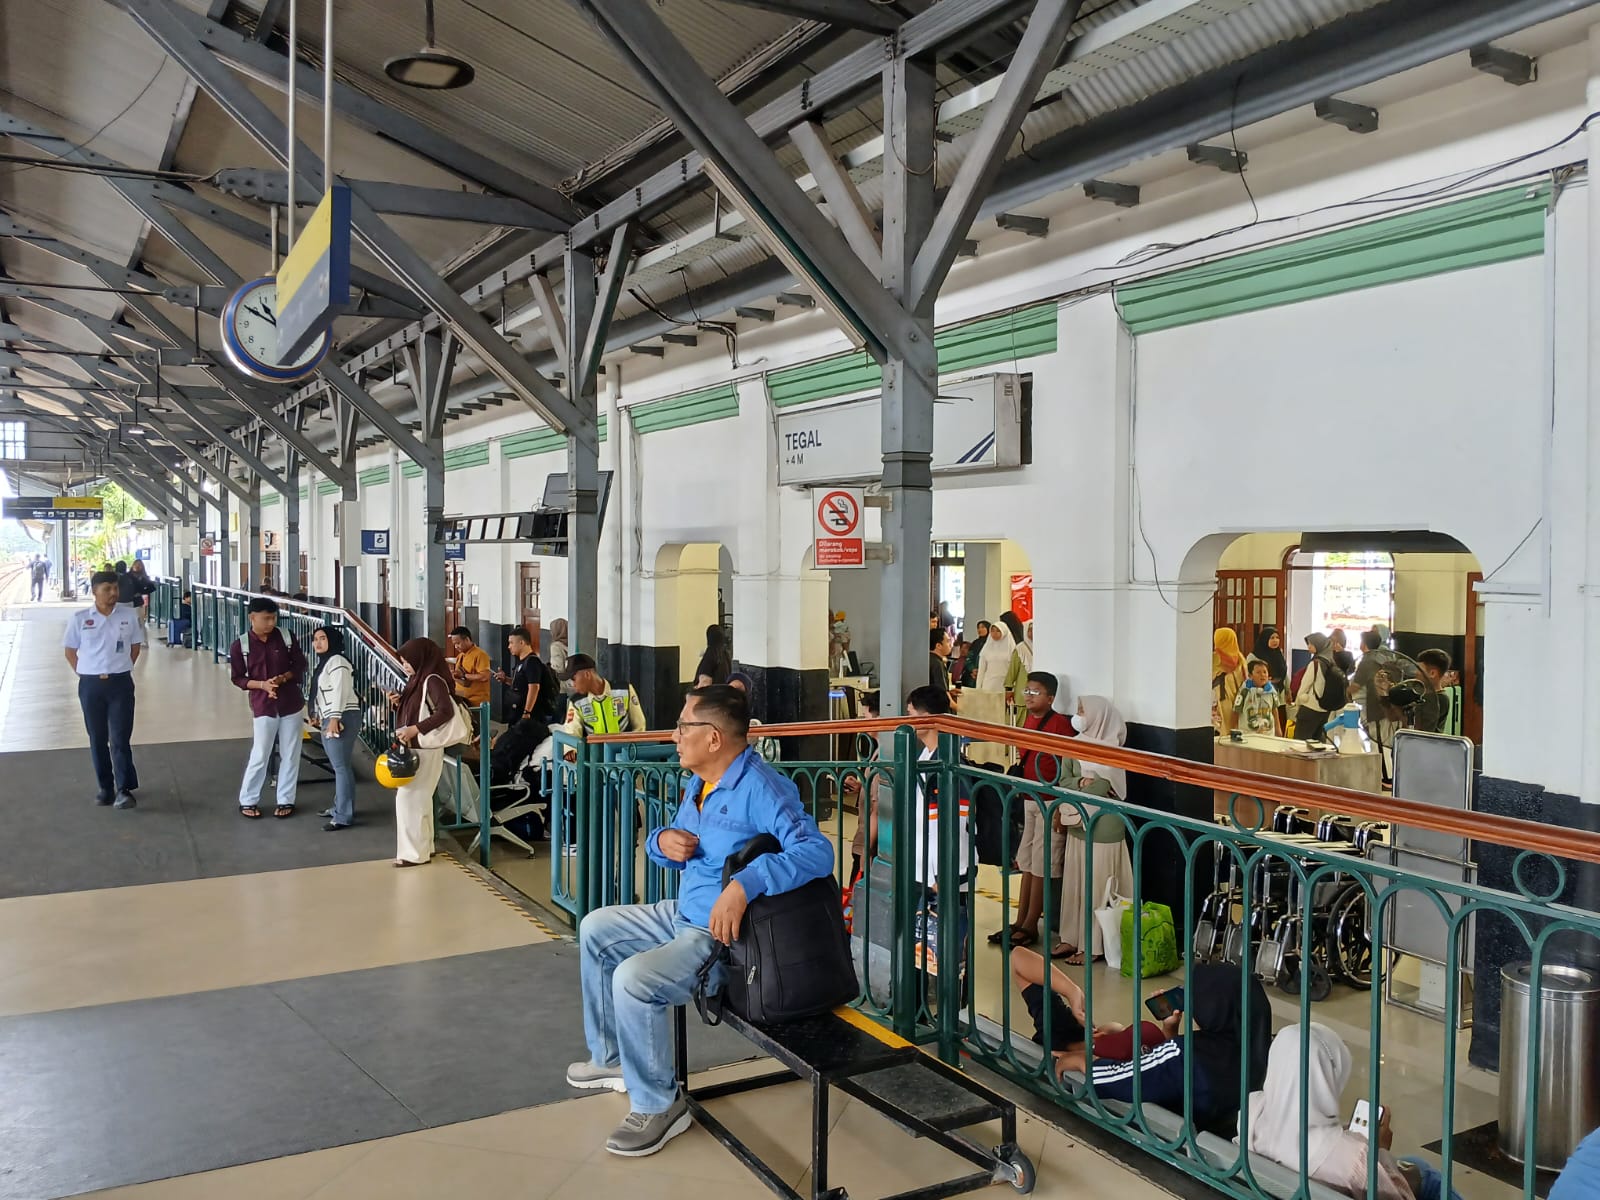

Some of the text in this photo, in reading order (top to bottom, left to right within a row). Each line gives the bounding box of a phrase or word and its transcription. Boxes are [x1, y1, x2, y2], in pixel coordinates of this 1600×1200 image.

[243, 320, 250, 329] 9
[248, 335, 254, 343] 8
[260, 347, 265, 355] 7
[785, 429, 822, 451] TEGAL
[818, 540, 843, 549] Dilarang
